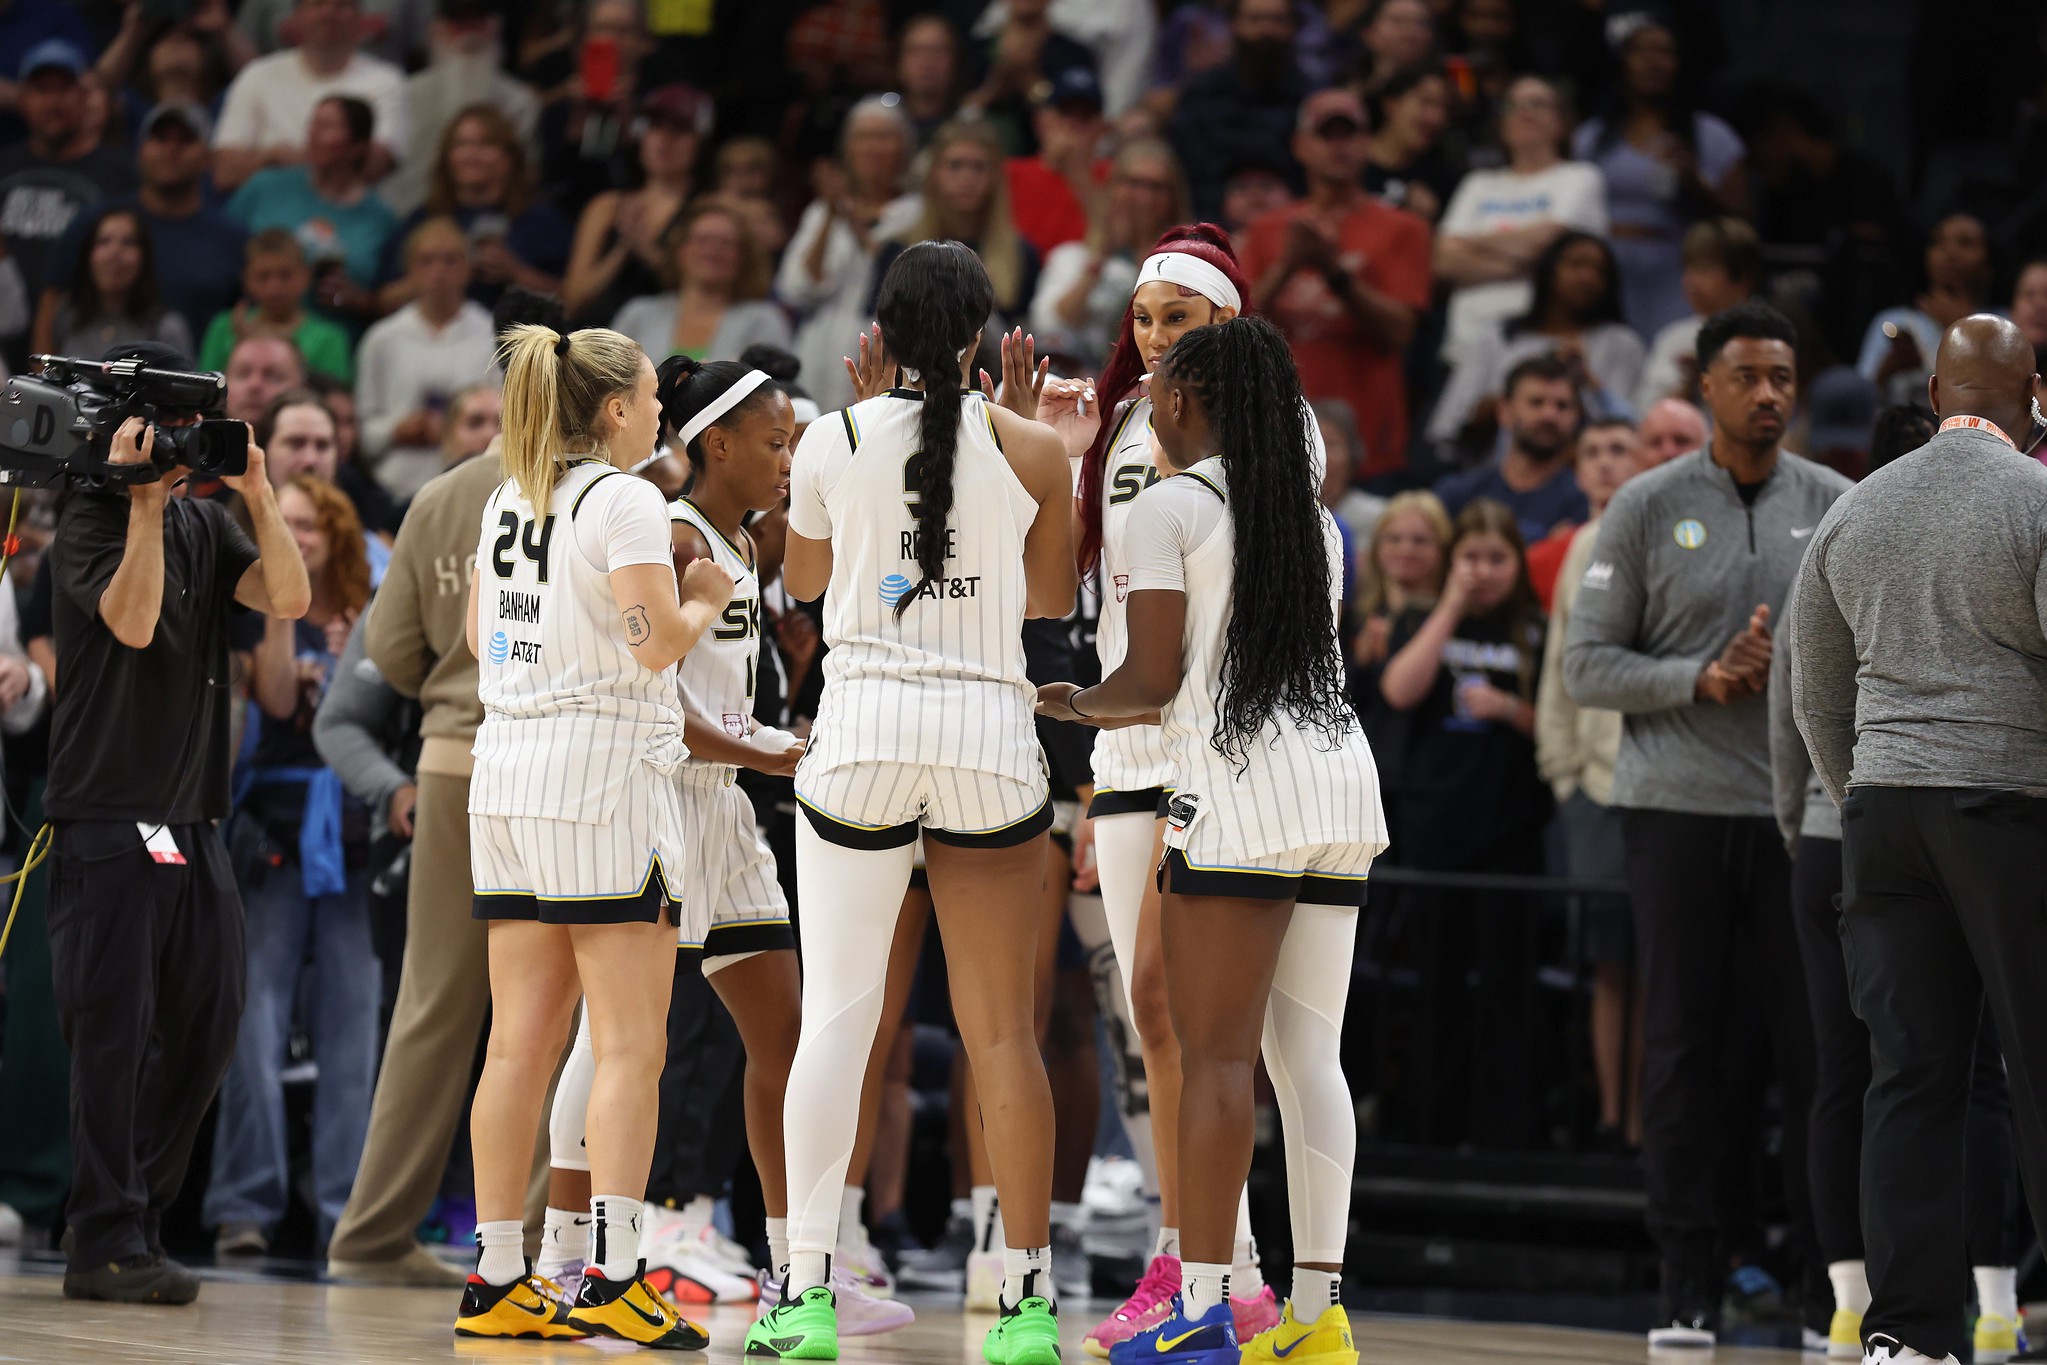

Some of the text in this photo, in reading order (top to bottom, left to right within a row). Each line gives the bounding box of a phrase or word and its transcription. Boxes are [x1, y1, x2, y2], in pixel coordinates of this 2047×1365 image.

[32, 404, 55, 445] D
[1967, 417, 1981, 429] W
[492, 509, 557, 585] 24
[901, 529, 956, 560] REE
[918, 576, 981, 600] AT&T
[499, 589, 541, 624] BANHAM
[511, 640, 542, 664] AT&T
